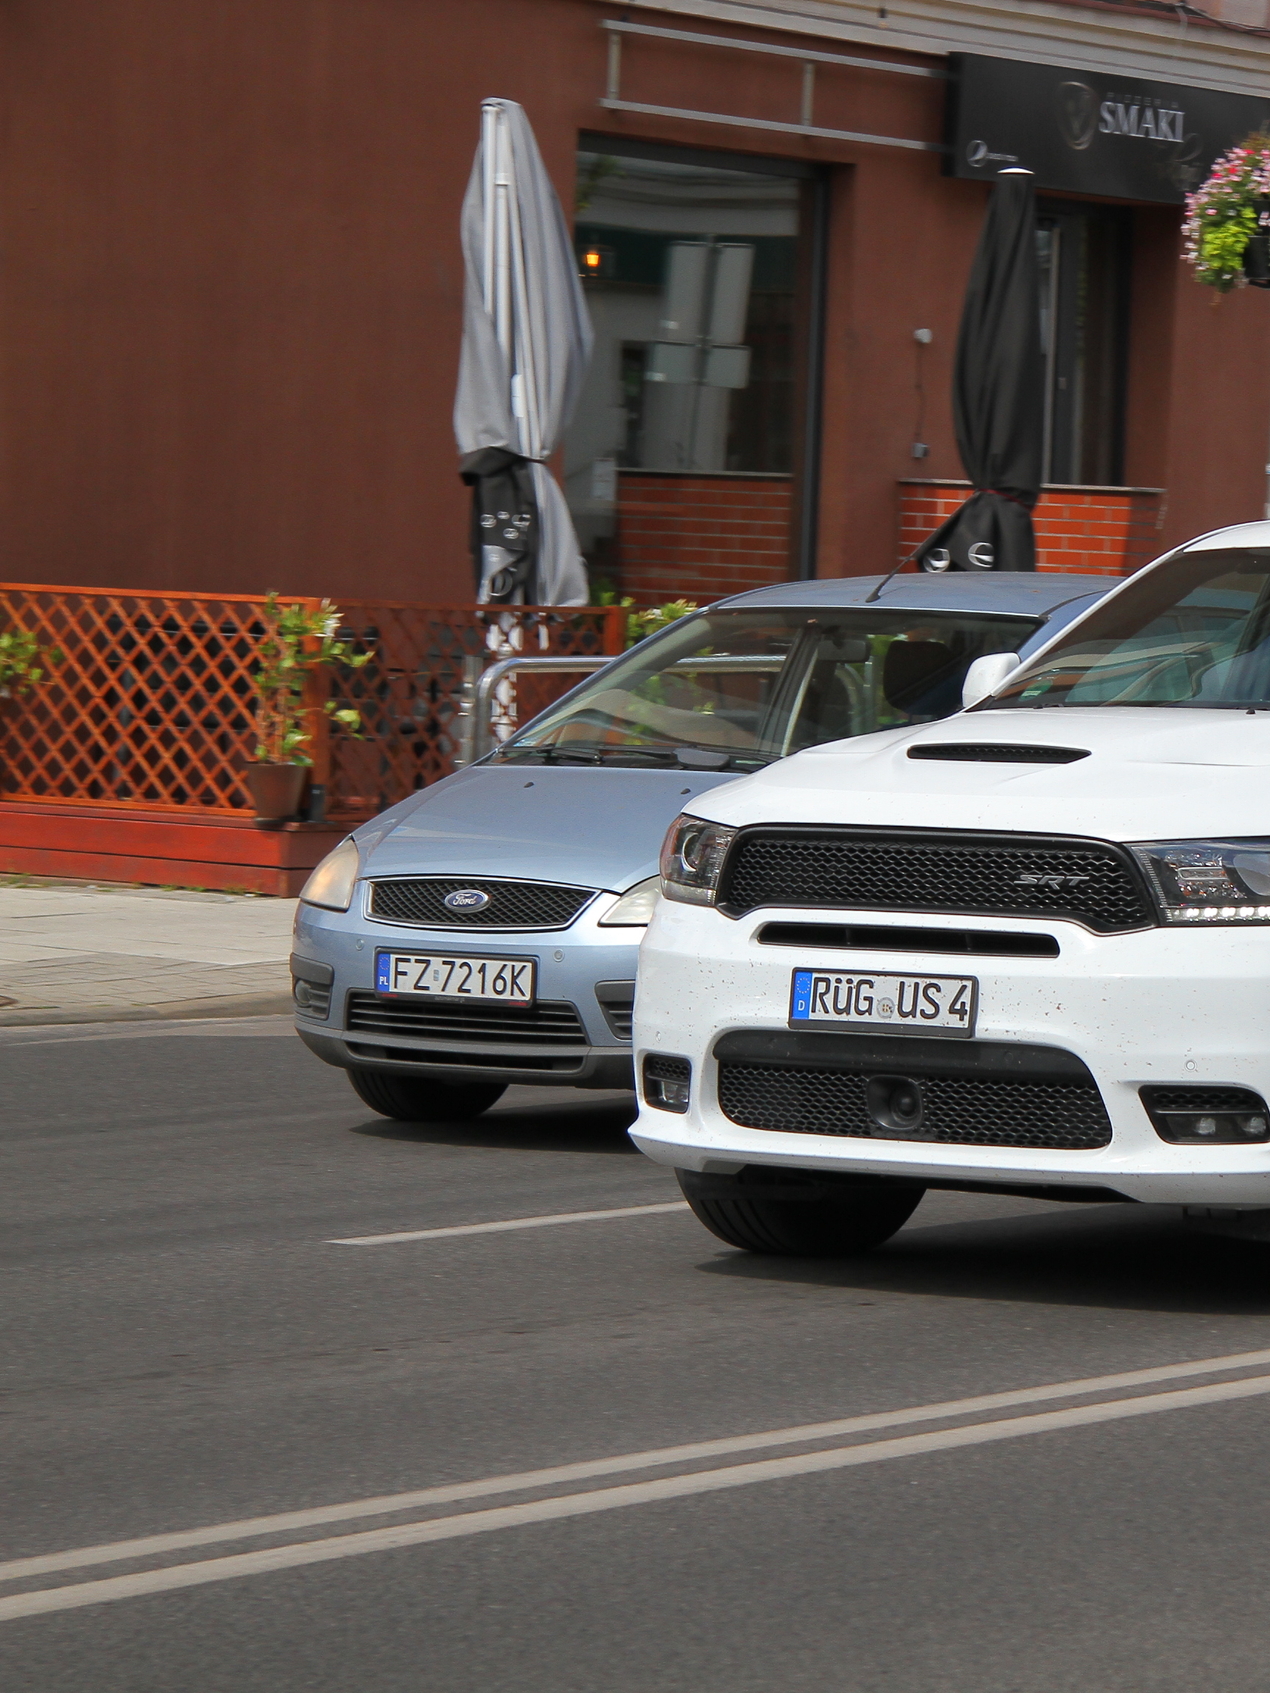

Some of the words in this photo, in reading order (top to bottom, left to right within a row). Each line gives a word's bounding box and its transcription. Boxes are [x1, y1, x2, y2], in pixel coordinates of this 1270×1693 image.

[1098, 101, 1185, 142] SMAKI
[1013, 874, 1090, 890] SRT
[452, 893, 478, 906] Ford
[379, 976, 389, 986] PL
[441, 959, 528, 997] 7216K
[797, 1000, 806, 1011] D
[897, 980, 942, 1020] US
